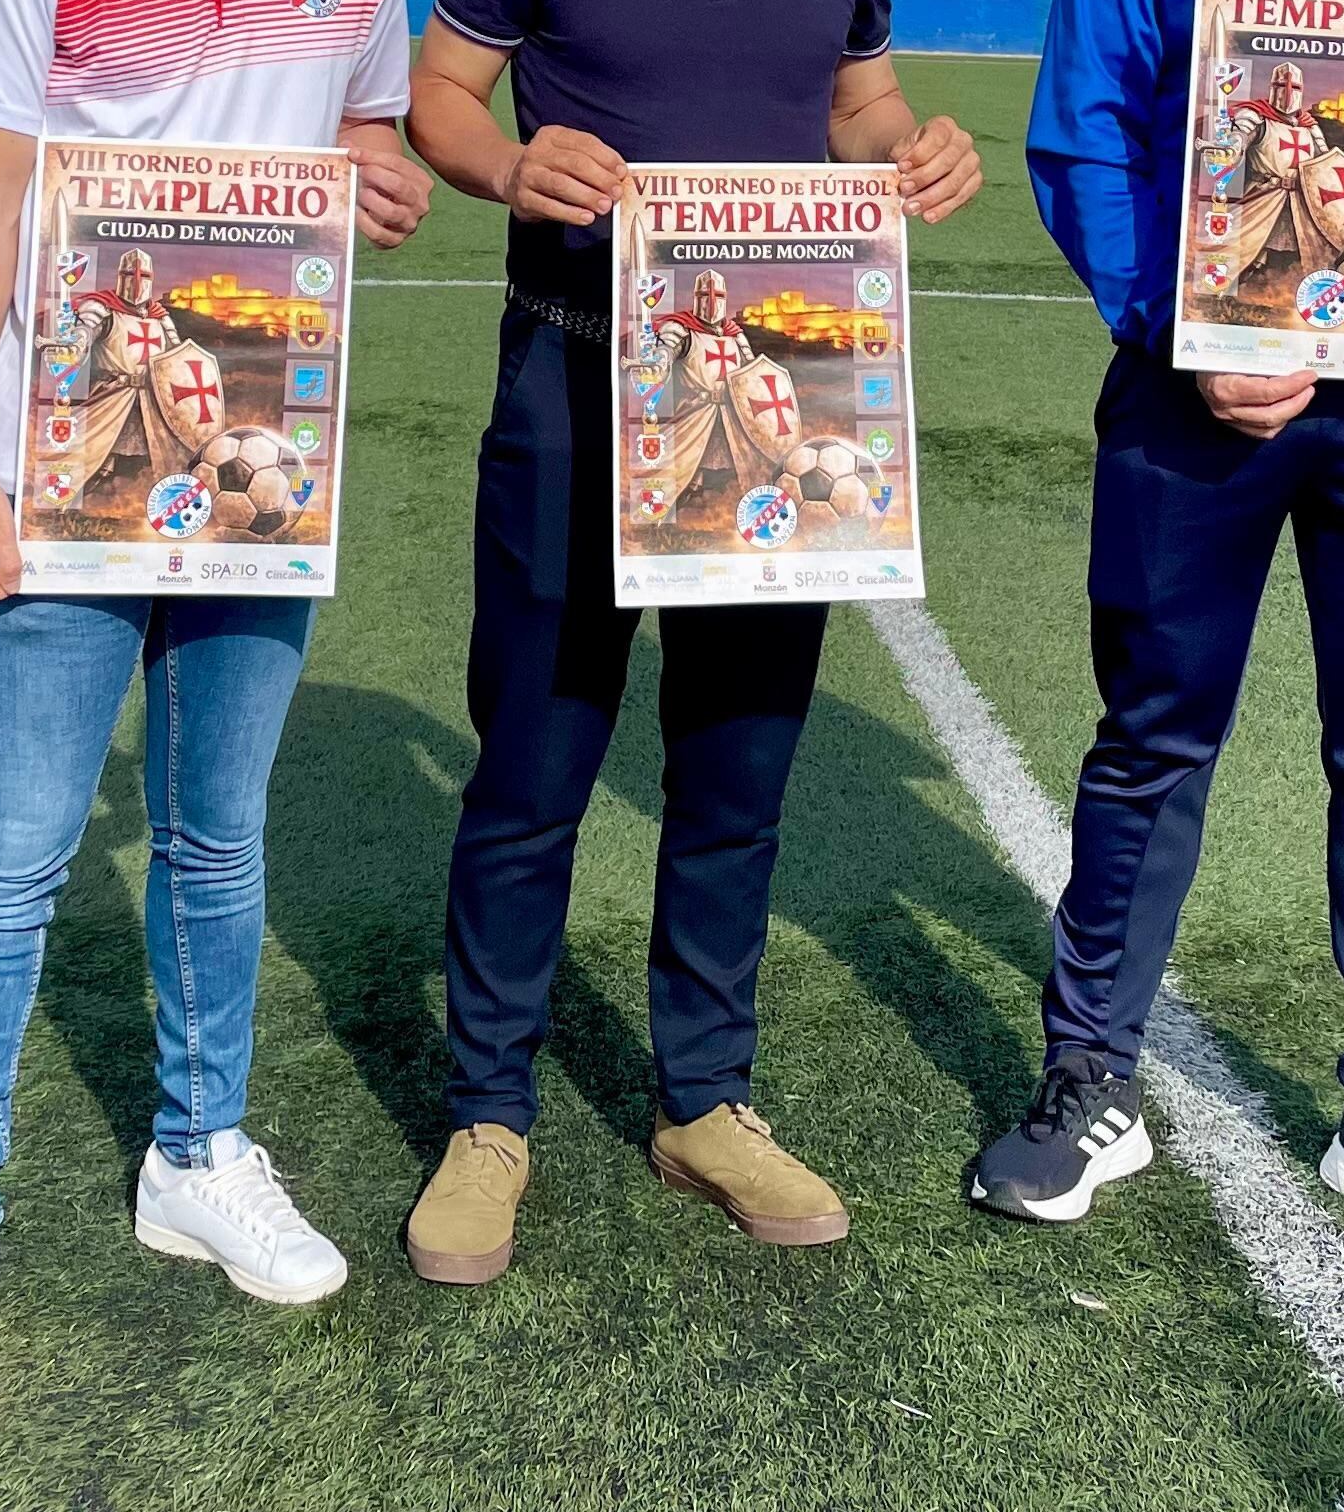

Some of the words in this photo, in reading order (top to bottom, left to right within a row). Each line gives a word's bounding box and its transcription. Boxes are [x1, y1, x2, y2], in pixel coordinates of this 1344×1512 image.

[1251, 36, 1325, 55] CIUDAD
[56, 148, 107, 172] VIII
[112, 153, 213, 175] TORNEO
[219, 161, 244, 177] DE
[250, 156, 340, 182] FÚTBOL
[632, 175, 678, 196] VIII
[683, 177, 775, 196] TORNEO
[781, 181, 804, 196] DE
[810, 173, 891, 196] FÚTBOL
[69, 175, 329, 218] TEMPLARIO
[645, 201, 883, 233] TEMPLARIO
[96, 220, 176, 240] CIUDAD
[179, 225, 206, 241] DE
[209, 225, 295, 244] MONZÓN
[672, 243, 745, 260] CIUDAD
[748, 244, 773, 260] DE
[776, 240, 854, 260] MONZÓN
[157, 574, 192, 583] Monzón
[200, 563, 258, 579] SPAZIO
[265, 569, 325, 581] CincaMedio
[794, 570, 849, 587] SPAZIO
[856, 574, 914, 585] CincaMedio
[754, 583, 788, 593] Monzón
